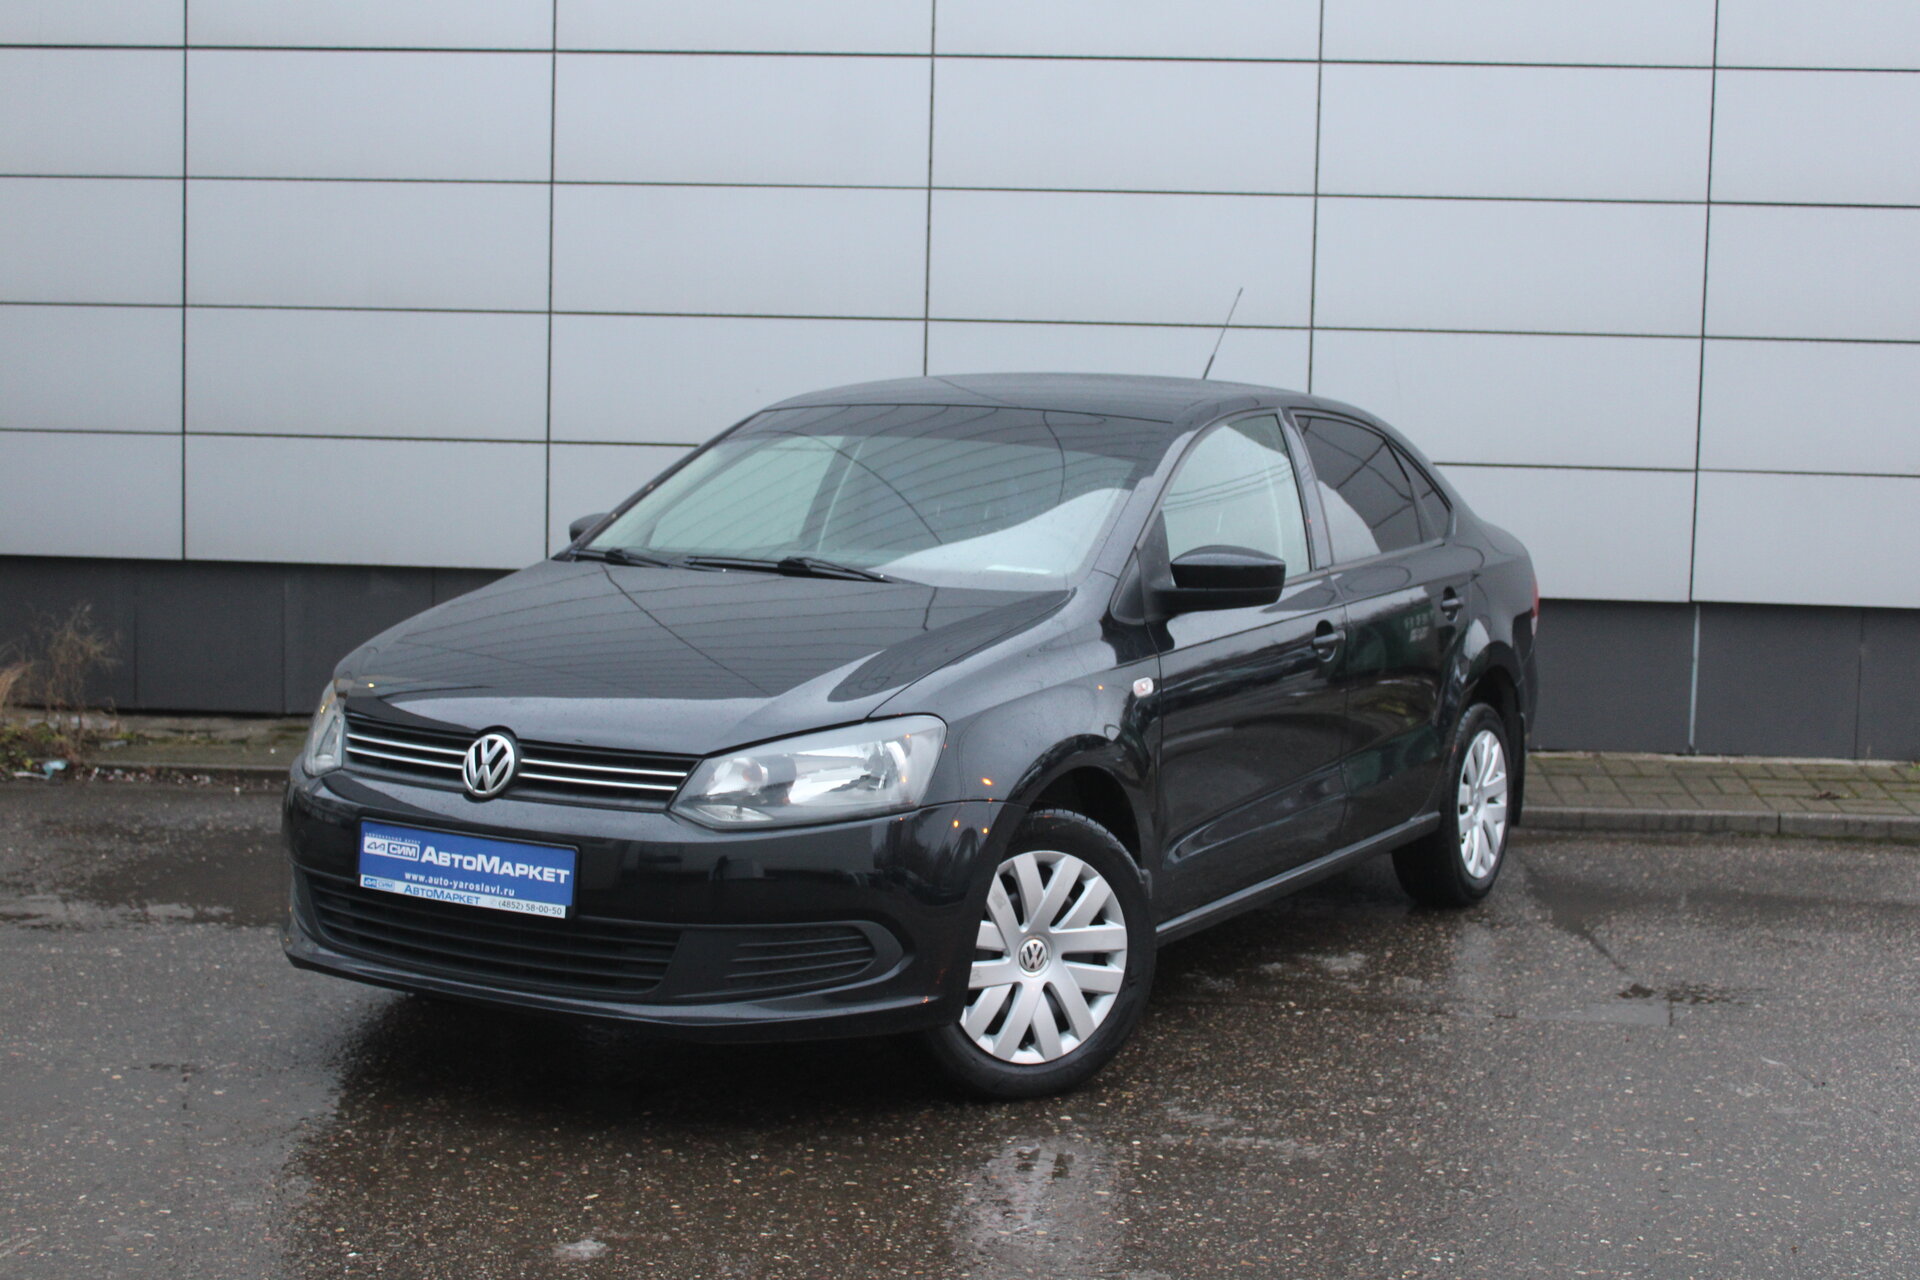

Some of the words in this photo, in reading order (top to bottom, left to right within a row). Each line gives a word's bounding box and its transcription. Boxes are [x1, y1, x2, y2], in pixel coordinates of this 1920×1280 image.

[388, 843, 417, 858] СИМ
[404, 872, 515, 897] www.auto-yaroslavl.ru
[498, 899, 525, 912] (4852)
[525, 902, 563, 916] 58-00-50
